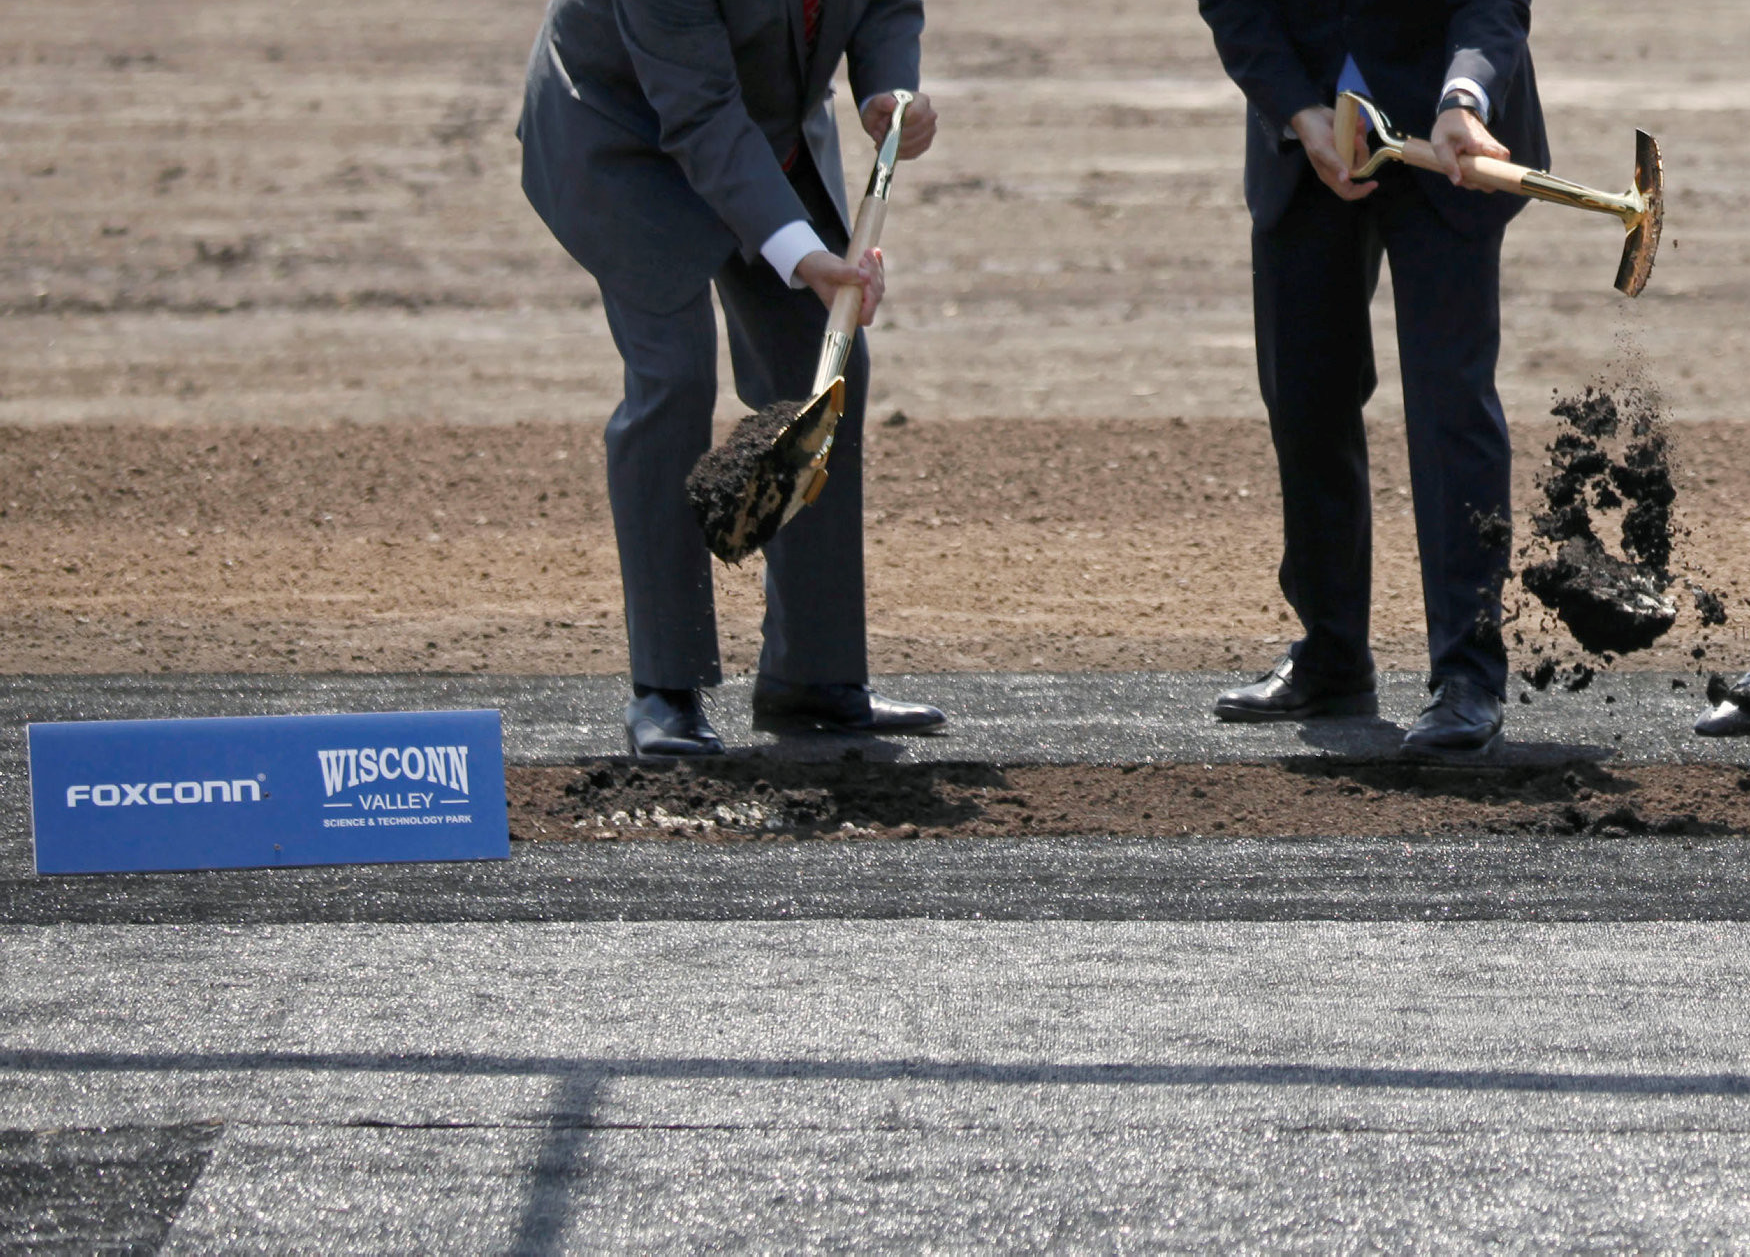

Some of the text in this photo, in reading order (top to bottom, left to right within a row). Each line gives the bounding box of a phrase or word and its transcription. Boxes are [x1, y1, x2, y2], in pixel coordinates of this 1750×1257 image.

[318, 746, 469, 797] WISCONN
[67, 779, 261, 807] FOXCONN
[358, 792, 434, 810] VALLEY
[323, 815, 472, 828] SCIENCE & TECHNOLOGY PARK
